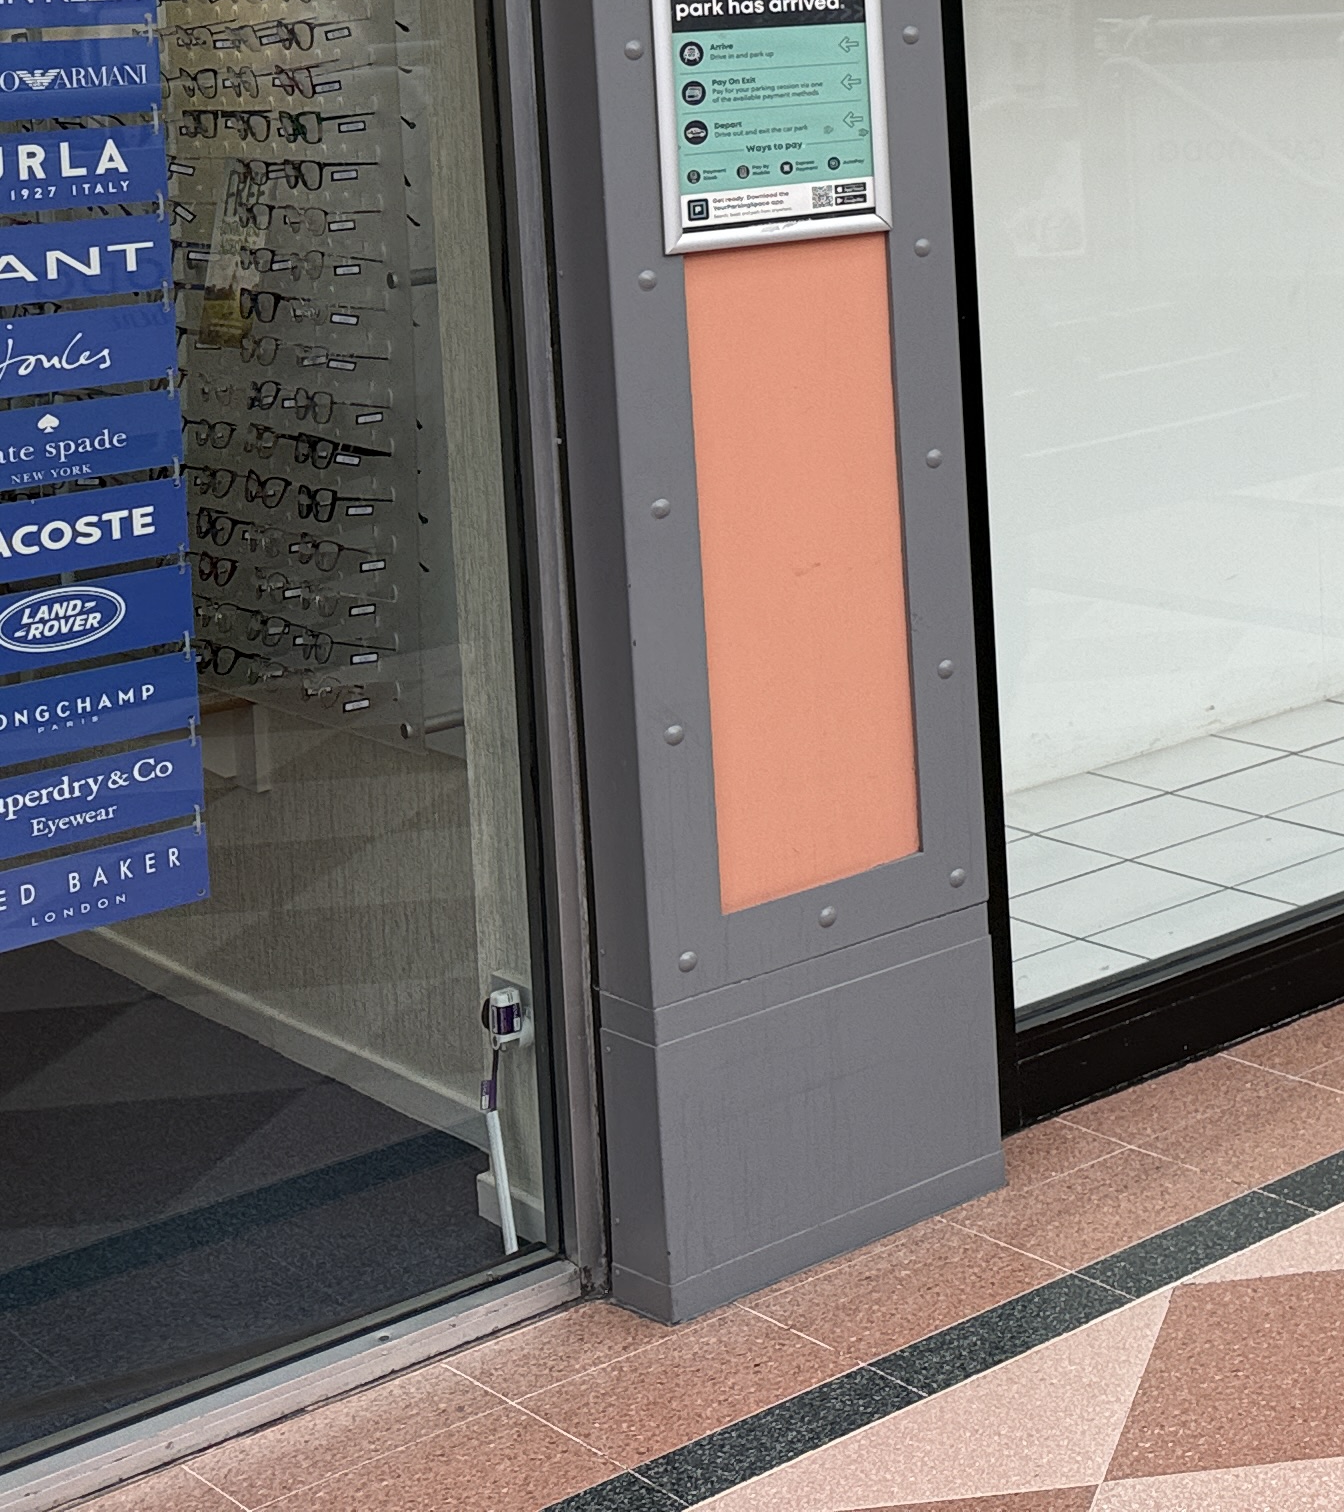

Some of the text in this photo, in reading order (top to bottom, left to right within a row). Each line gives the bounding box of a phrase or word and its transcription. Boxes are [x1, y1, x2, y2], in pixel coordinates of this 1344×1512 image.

[54, 63, 148, 89] ARMANI
[711, 78, 728, 88] Pay
[0, 138, 129, 181] RLA
[745, 141, 804, 155] Ways to pay
[10, 180, 130, 202] 1927 ITALY
[0, 241, 155, 282] ANT
[45, 428, 128, 463] spade
[11, 463, 92, 485] NEW YORK
[21, 599, 83, 625] LAND
[27, 612, 102, 641] ROVER
[37, 715, 100, 734] PARIS
[107, 770, 131, 789] &
[133, 757, 174, 782] Co
[30, 804, 118, 837] Eyewear
[68, 846, 182, 893] BAKER
[31, 893, 128, 927] LONDON
